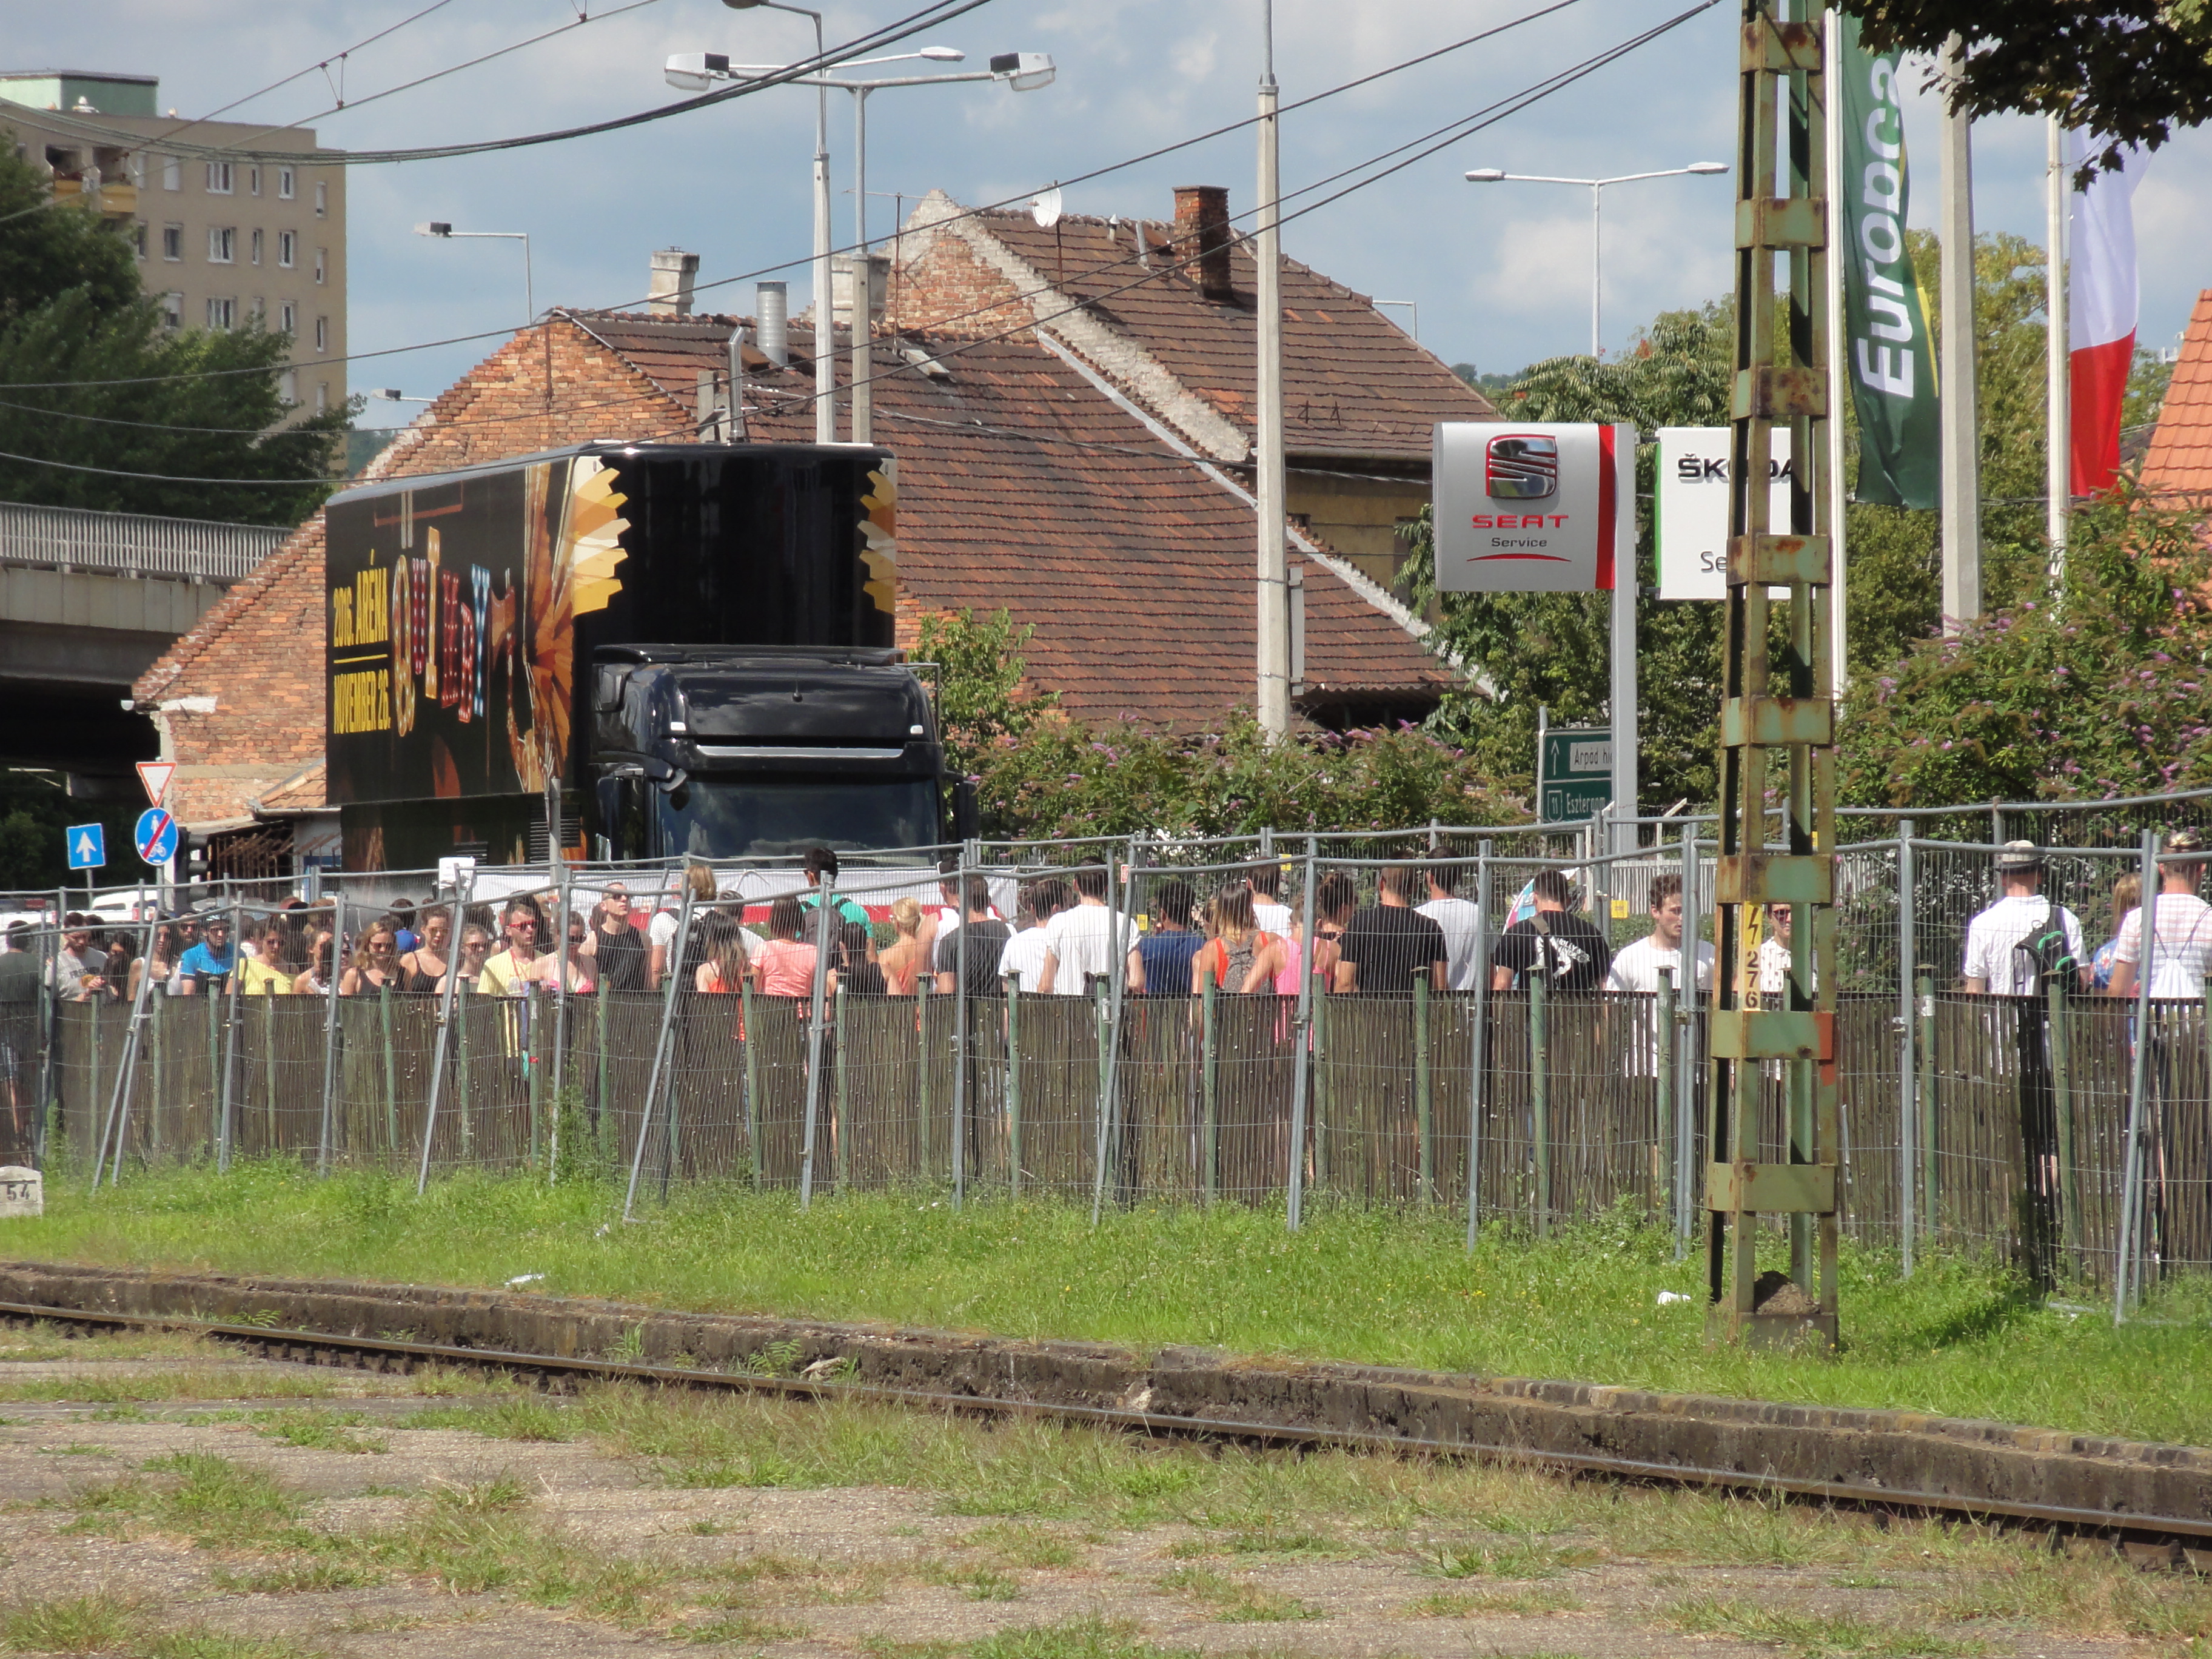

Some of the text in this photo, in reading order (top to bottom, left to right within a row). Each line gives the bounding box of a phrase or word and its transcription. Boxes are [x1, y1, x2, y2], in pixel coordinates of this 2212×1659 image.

[1855, 58, 1914, 398] Europca
[1678, 453, 1792, 478] ŠKDA
[1472, 514, 1569, 529] SEAT
[1490, 537, 1547, 548] Service
[333, 668, 391, 734] NOVEMBER 26.
[1552, 797, 1558, 814] 11
[1744, 950, 1759, 1008] 276
